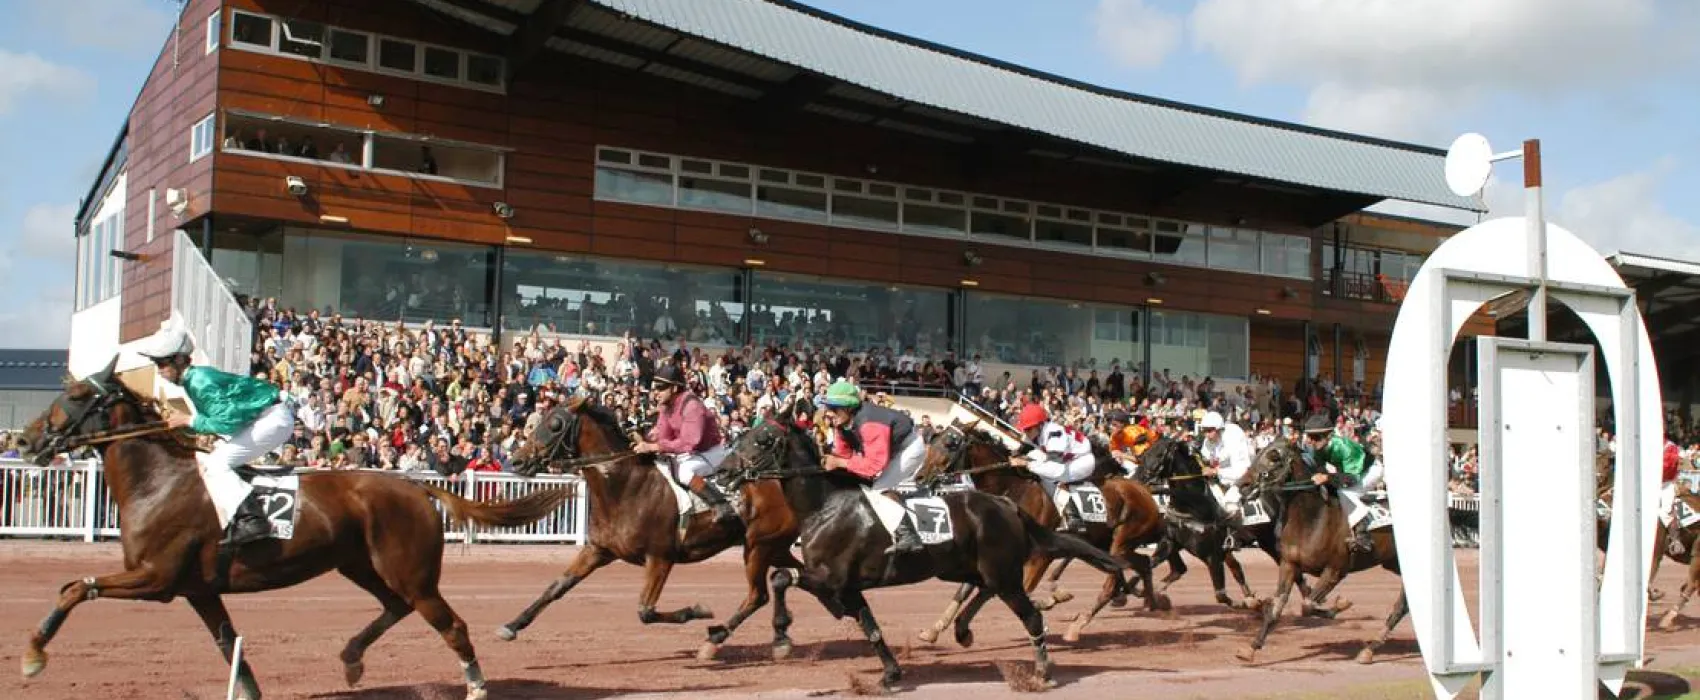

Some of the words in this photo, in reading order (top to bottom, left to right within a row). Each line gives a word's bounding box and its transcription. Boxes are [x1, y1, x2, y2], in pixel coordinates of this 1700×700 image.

[257, 493, 294, 523] 12
[1087, 493, 1105, 514] 13
[928, 508, 946, 537] 7
